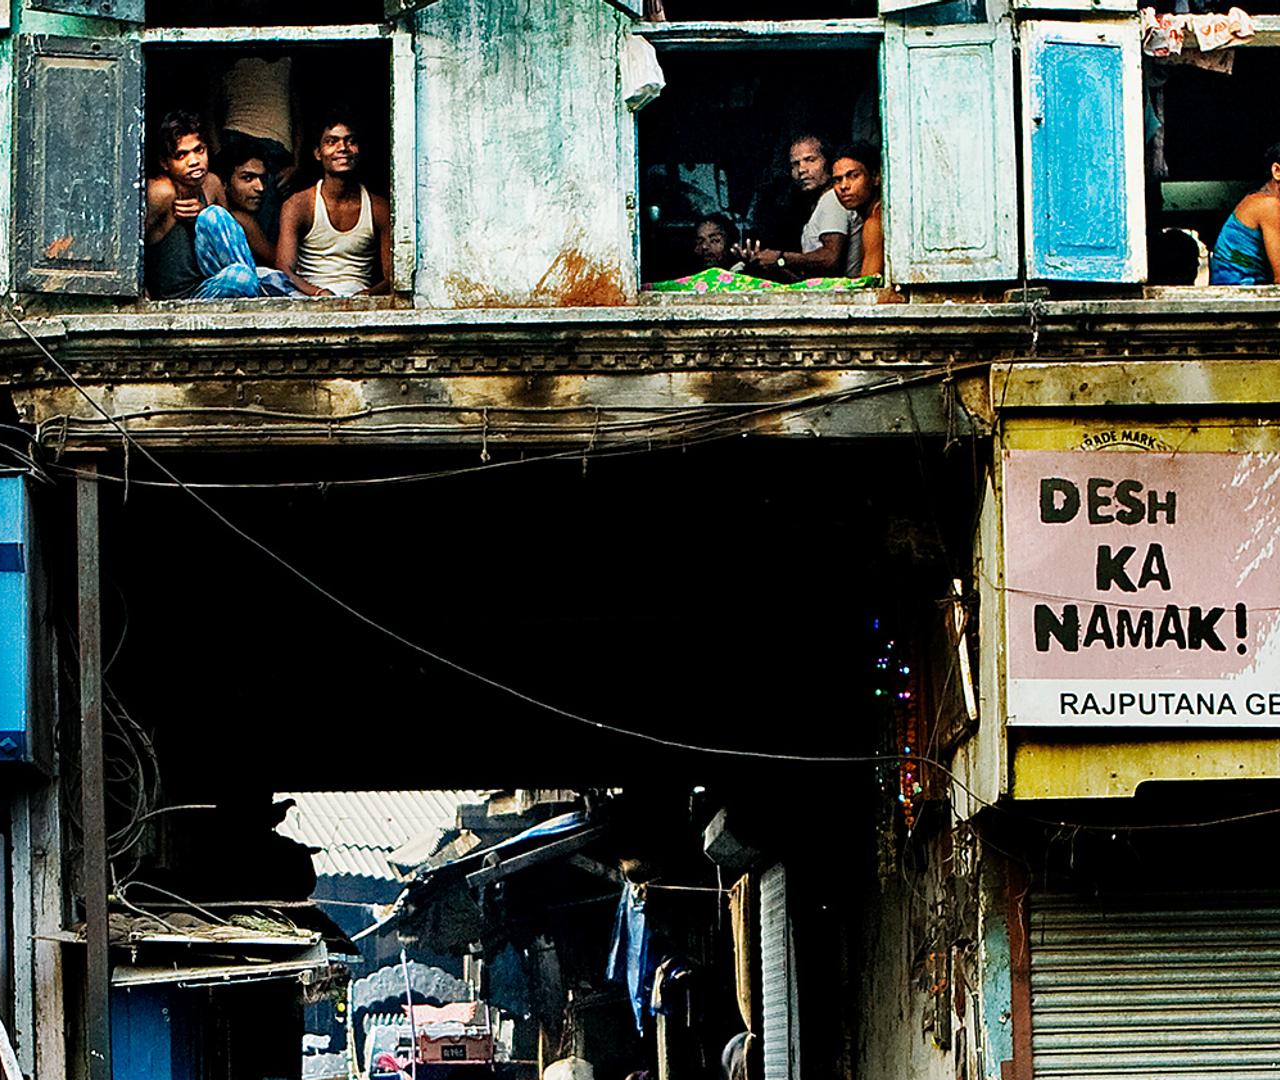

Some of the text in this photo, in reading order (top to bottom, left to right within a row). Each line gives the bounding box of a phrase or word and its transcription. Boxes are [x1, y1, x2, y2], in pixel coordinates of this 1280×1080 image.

[1096, 544, 1172, 592] KA
[1033, 603, 1248, 656] NAMAK!
[1060, 690, 1236, 717] RAJPUTANA
